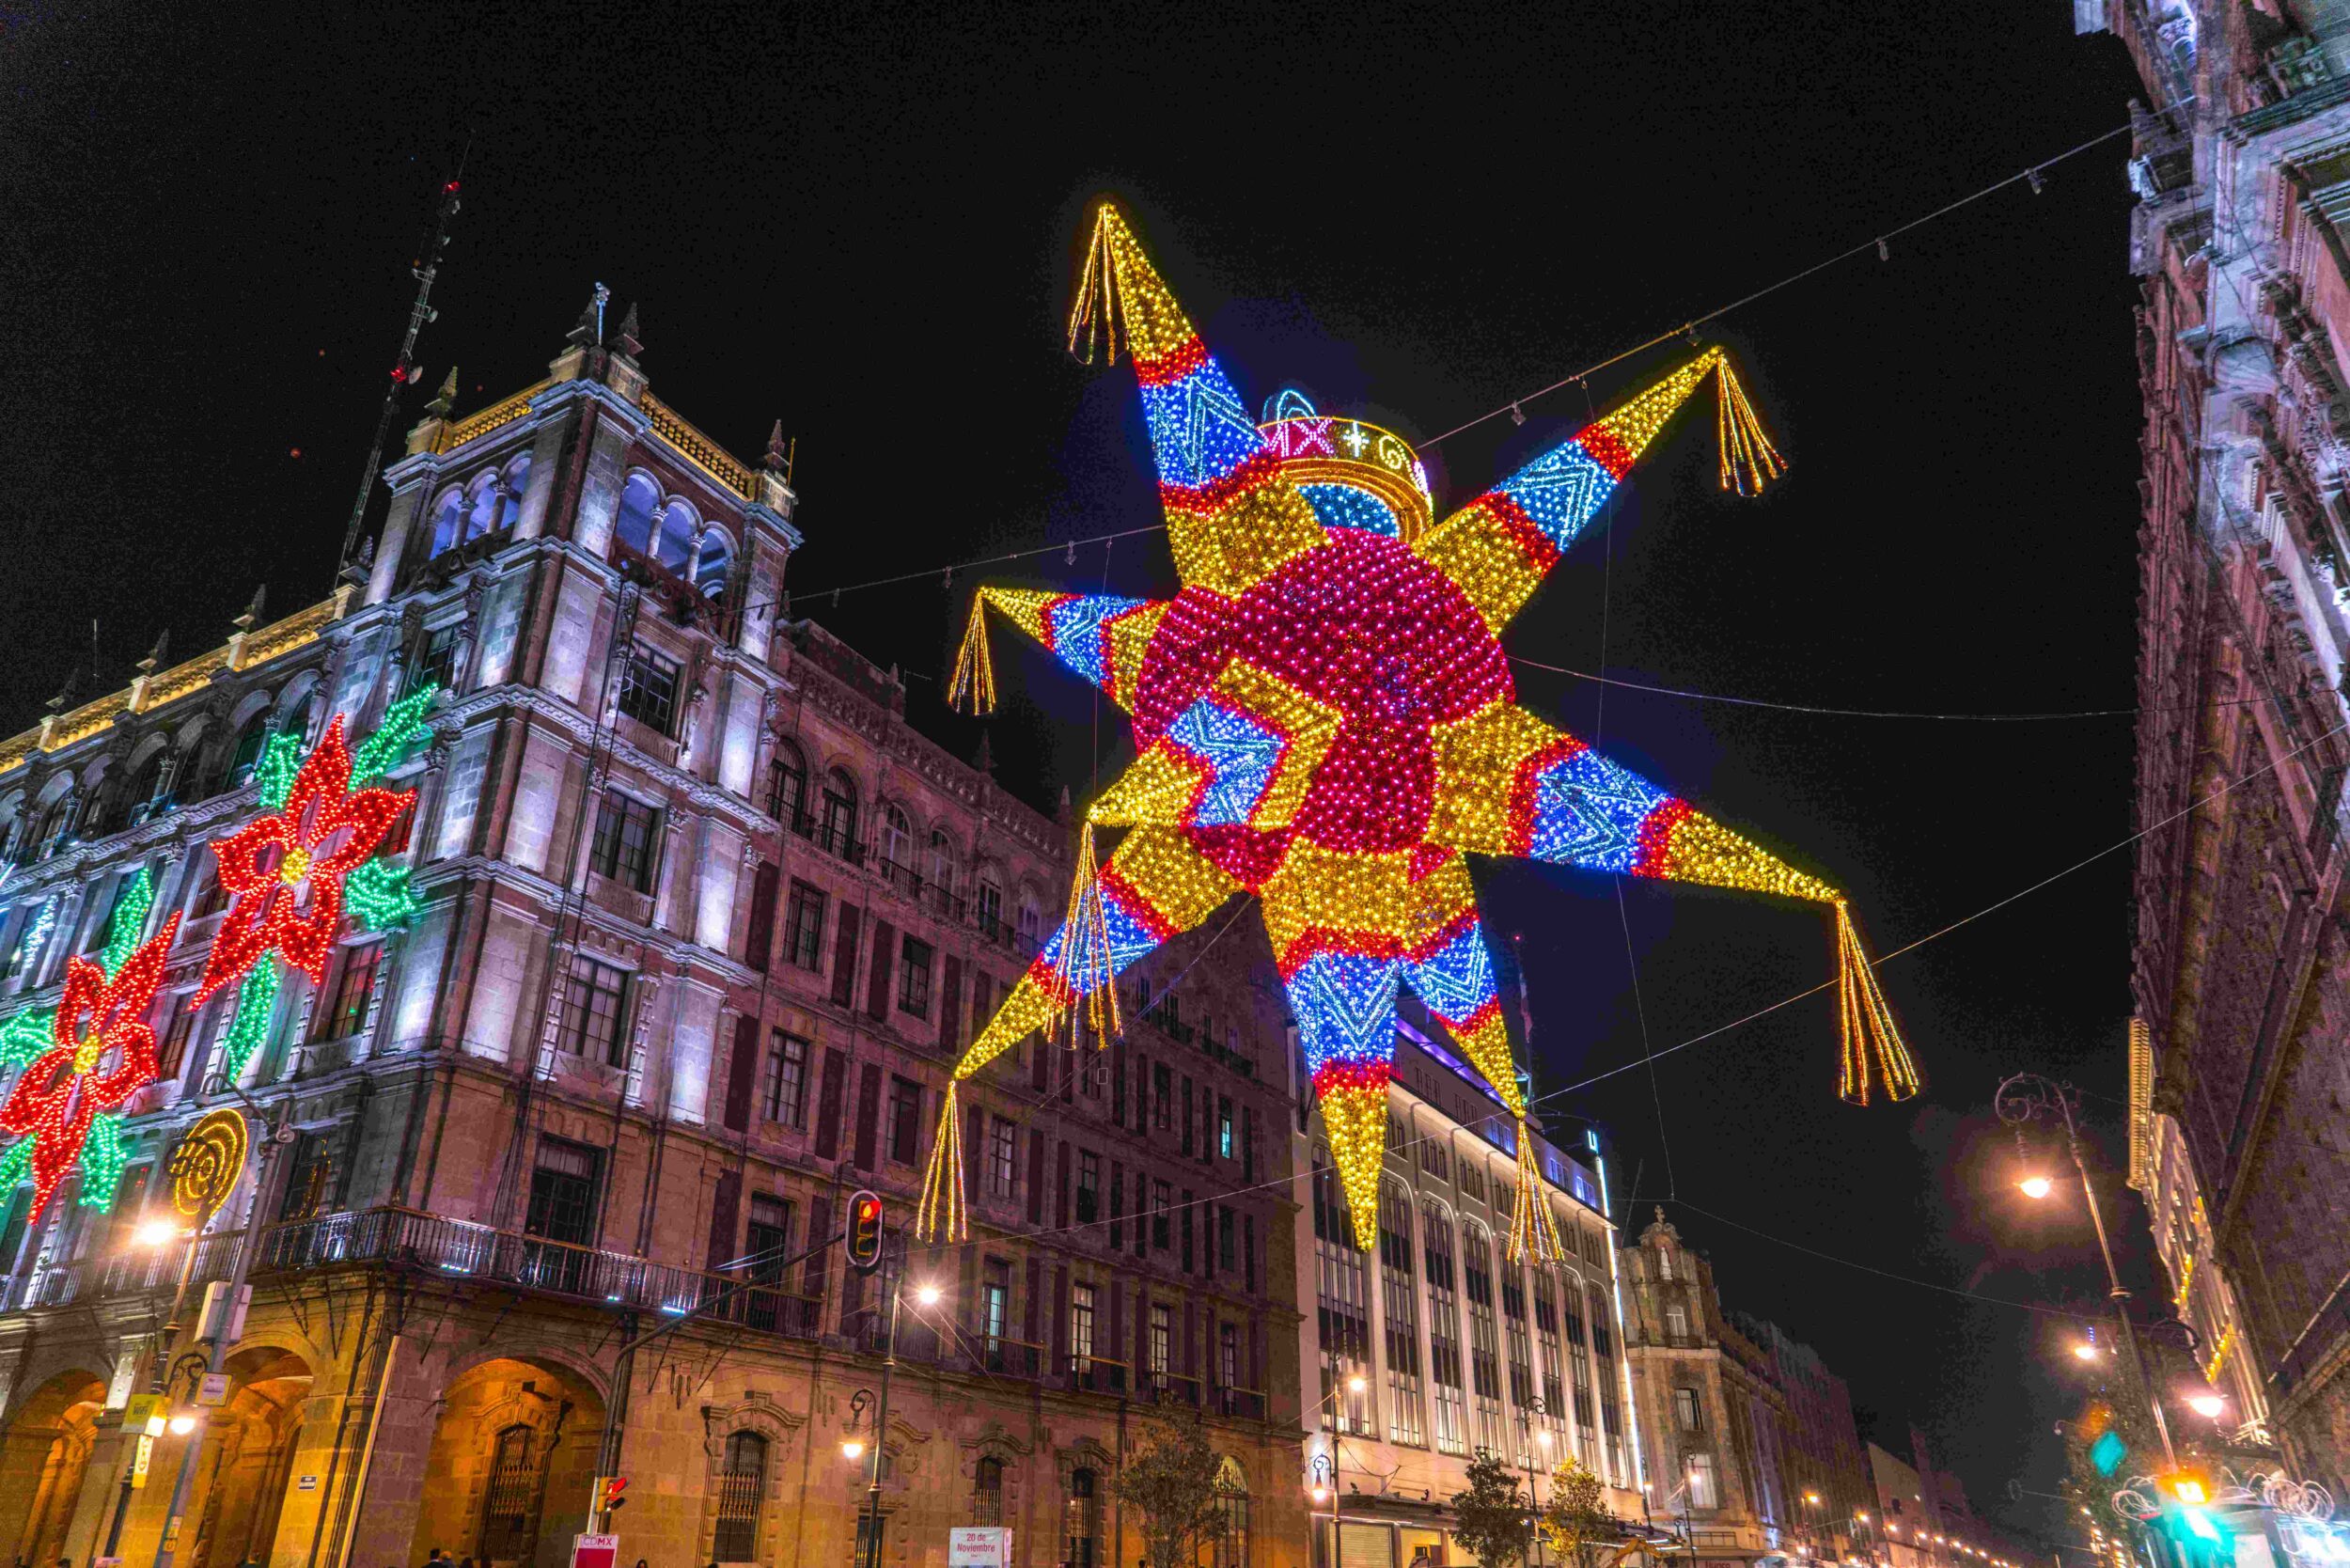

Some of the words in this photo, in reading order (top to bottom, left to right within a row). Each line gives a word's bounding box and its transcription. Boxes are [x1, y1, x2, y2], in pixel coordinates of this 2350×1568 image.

[583, 1536, 612, 1546] CDMX
[966, 1532, 976, 1542] 20
[978, 1532, 986, 1542] de
[957, 1543, 995, 1553] Noviembre
